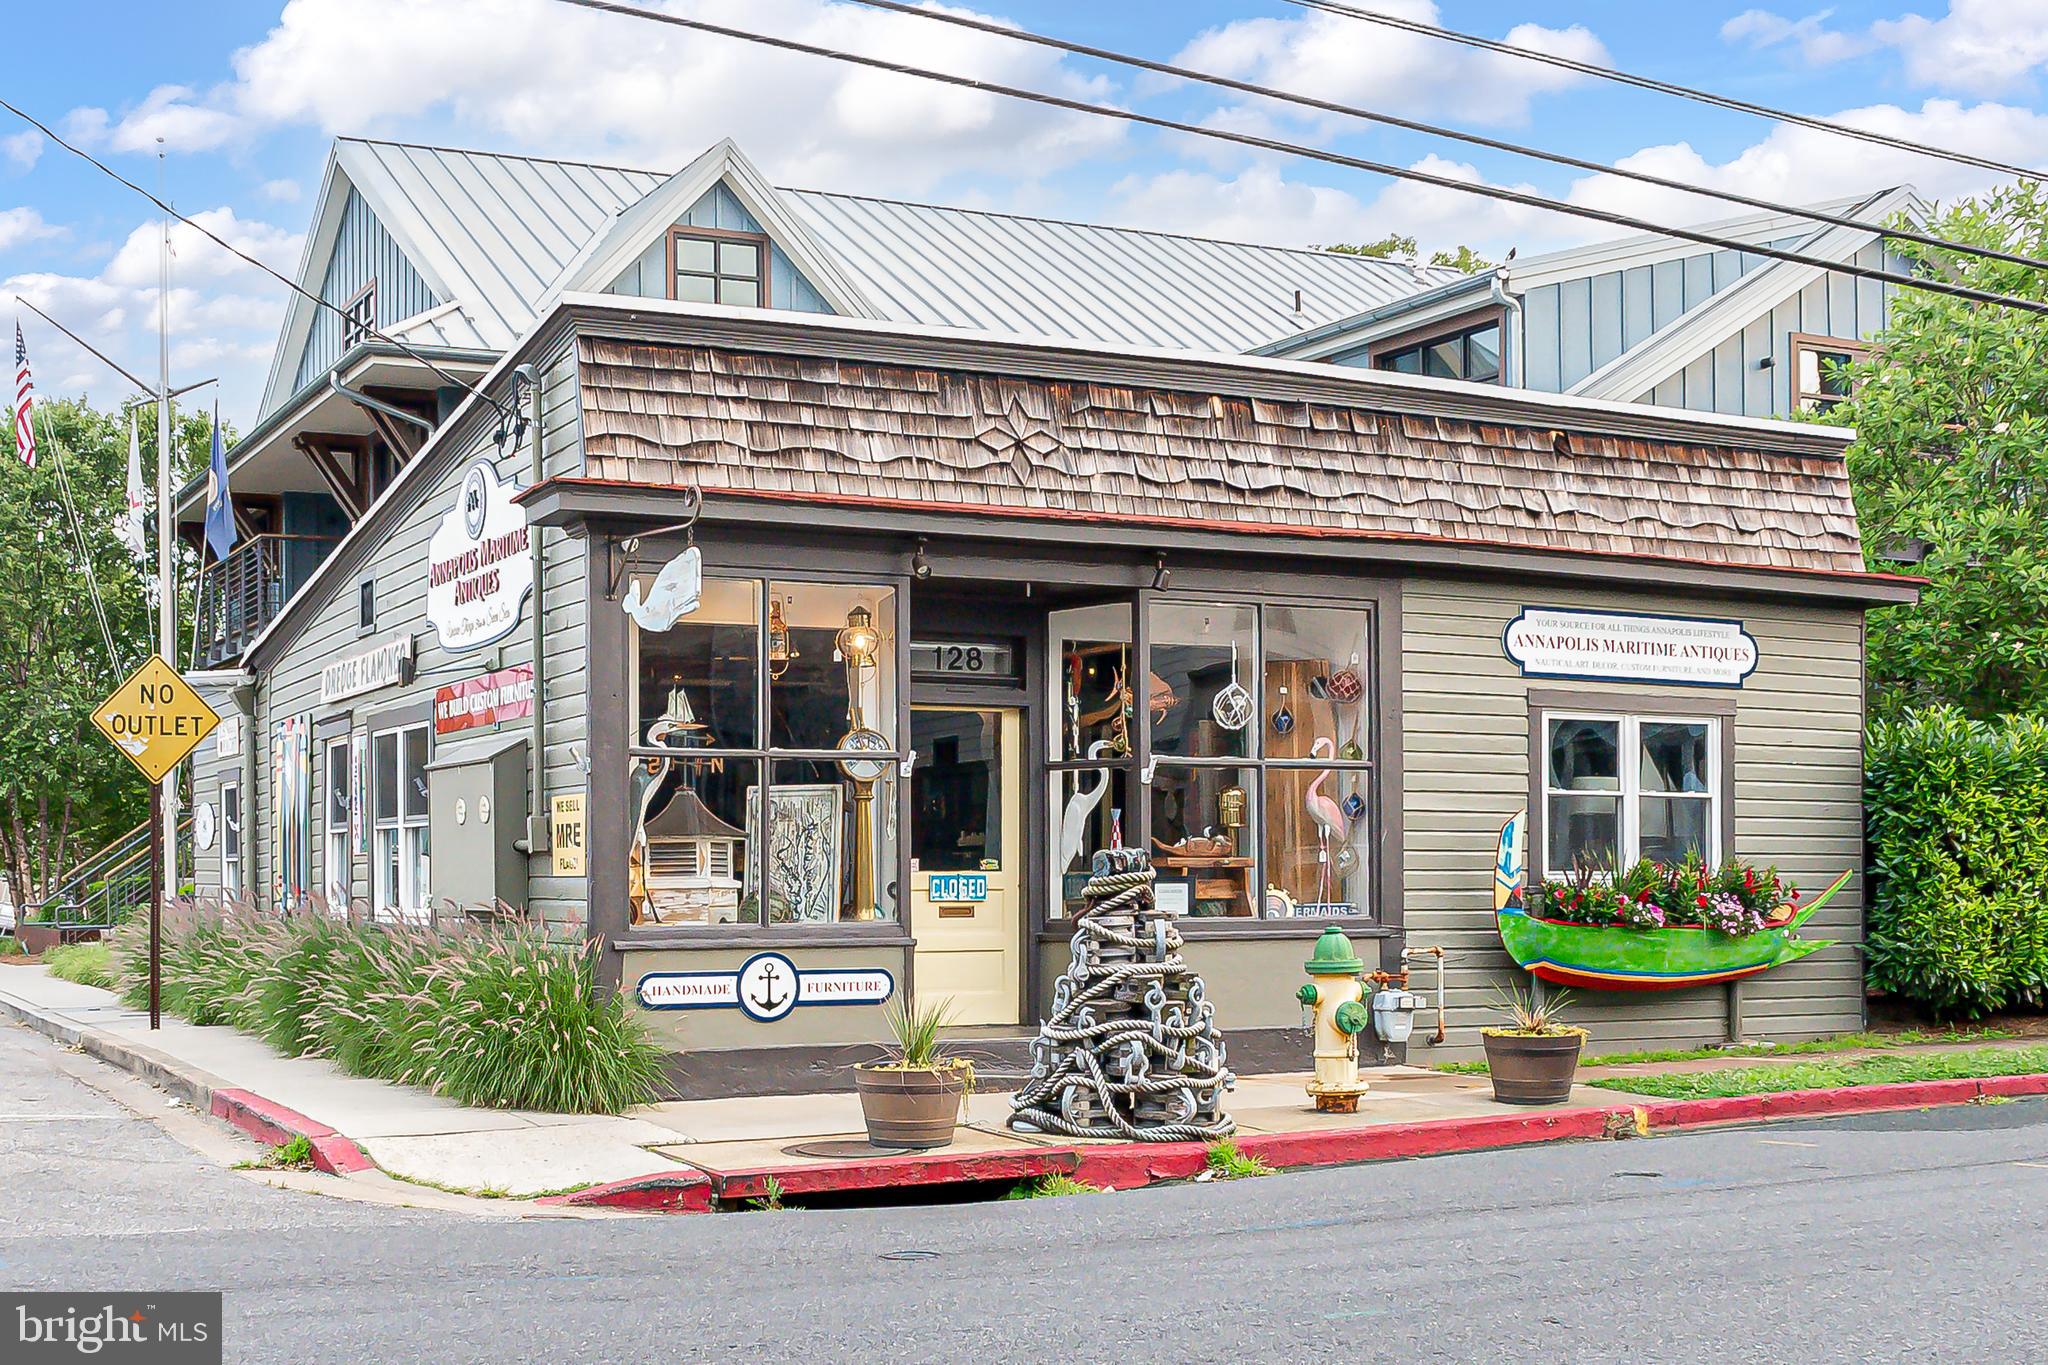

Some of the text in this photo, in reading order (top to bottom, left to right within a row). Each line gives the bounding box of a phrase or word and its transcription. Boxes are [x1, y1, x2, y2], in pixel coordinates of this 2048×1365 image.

[430, 527, 529, 589] ANNAPOLIS MARITIME
[455, 569, 500, 606] ANTIQUES
[1536, 618, 1730, 640] YOUR SOURCE FOR ALL THINGS ANNAPOLIS LIFESTYLE
[932, 646, 984, 671] 128
[1514, 633, 1749, 662] ANNAPOLIS MARITIME ANTIQUES
[140, 684, 174, 704] NO
[438, 700, 449, 720] WE
[112, 714, 203, 737] OUTLET
[556, 799, 580, 813] WE SELL
[556, 822, 581, 849] MRE
[932, 878, 985, 898] CLOSED
[652, 980, 882, 997] HANDMADE FURNITURE
